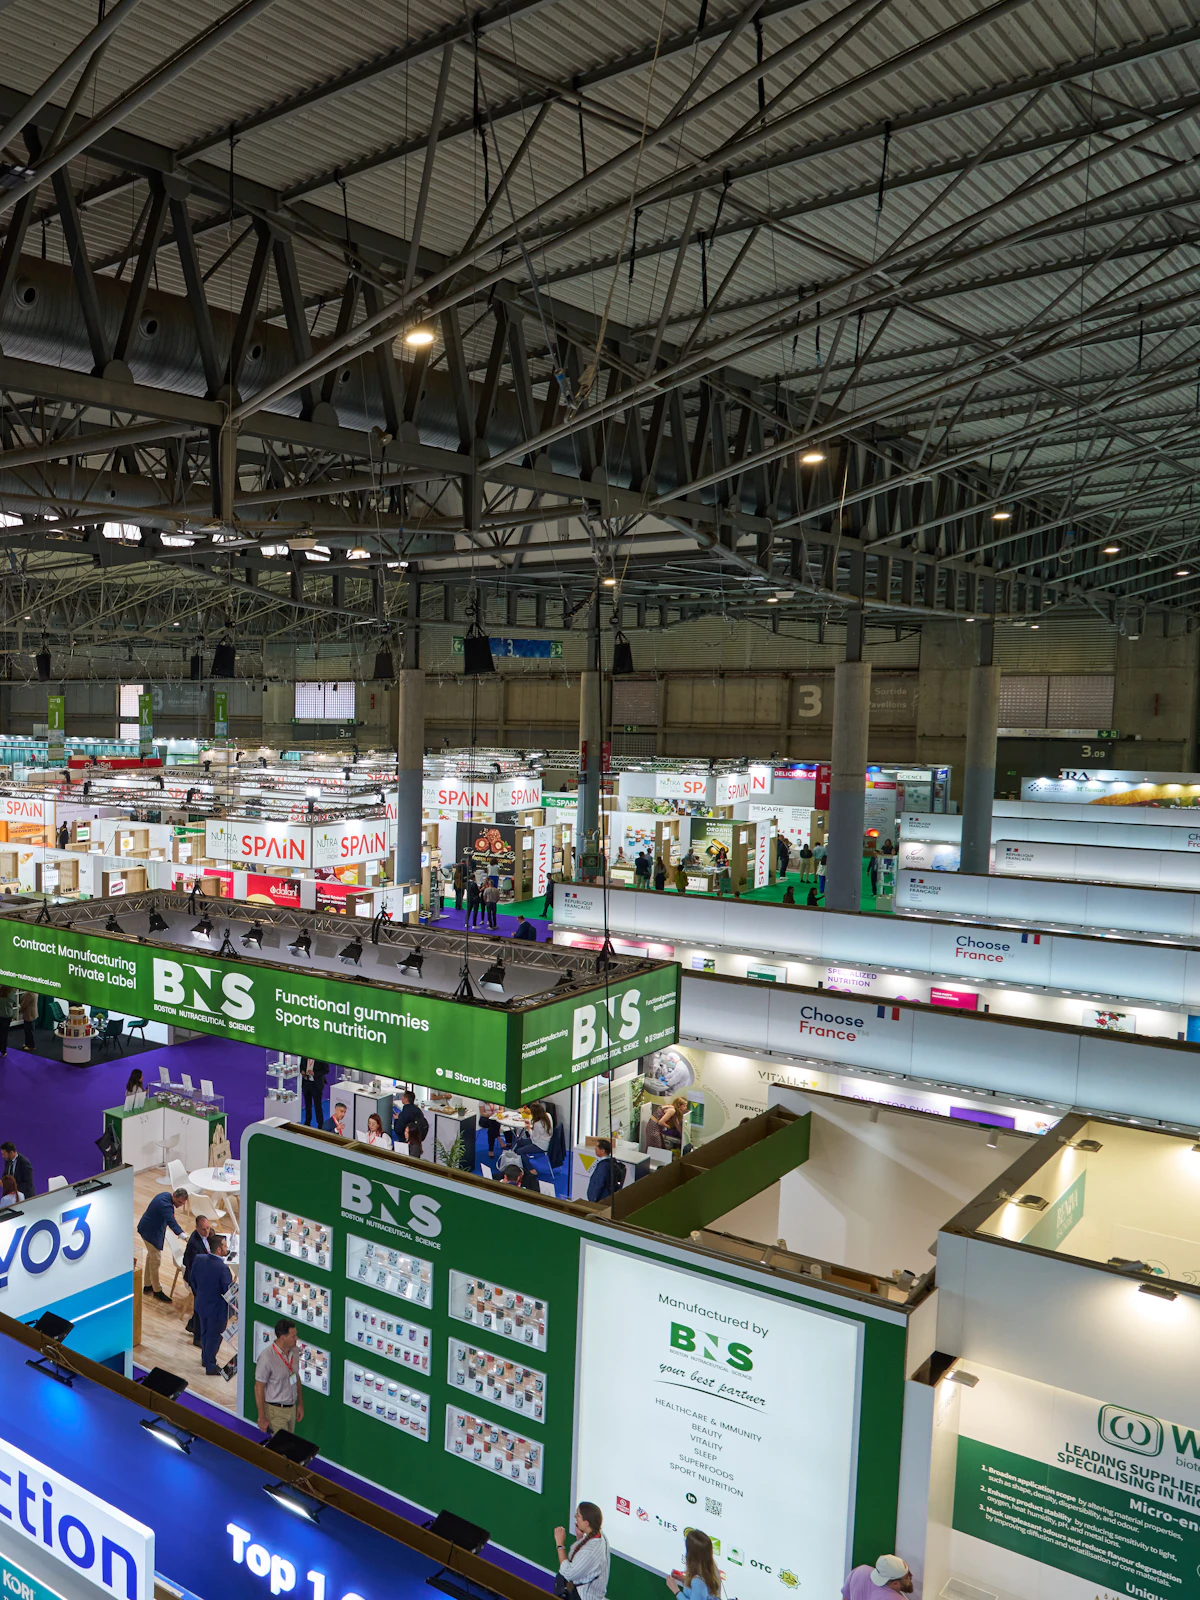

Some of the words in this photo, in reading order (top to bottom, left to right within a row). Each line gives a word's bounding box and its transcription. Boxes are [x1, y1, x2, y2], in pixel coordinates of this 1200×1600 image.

[142, 708, 149, 725] K
[219, 707, 224, 720] L
[798, 684, 822, 717] 3
[53, 712, 59, 729] J
[1081, 745, 1106, 758] 3.09
[13, 935, 56, 955] Contract
[57, 945, 137, 974] Manufacturing
[956, 935, 1010, 952] Choose
[68, 964, 105, 982] Private
[107, 973, 137, 990] Label
[153, 957, 256, 1020] BNS
[828, 975, 870, 987] NUTRITION
[154, 1003, 177, 1015] BOSTON
[179, 1009, 226, 1027] NUTRACEUTICAL
[228, 1021, 255, 1033] SCIENCE
[275, 988, 350, 1016] Functional
[354, 1006, 429, 1032] gummies
[275, 1008, 320, 1030] Sports
[323, 1021, 387, 1045] nutrition
[572, 989, 641, 1060] BNS
[800, 1006, 864, 1028] Choose
[455, 1072, 480, 1086] Stand
[481, 1077, 507, 1092] 3B136
[341, 1170, 442, 1238] BNS
[341, 1210, 364, 1224] BOSTON
[366, 1219, 413, 1241] NUTRACEUTICAL
[415, 1235, 441, 1250] SCIENCE
[658, 1293, 749, 1331] Manufactured
[752, 1322, 769, 1339] by
[670, 1321, 754, 1372] BNS
[659, 1363, 686, 1378] your
[690, 1370, 715, 1388] best
[717, 1383, 766, 1406] partner
[655, 1397, 708, 1422] HEALTHCARE
[711, 1417, 717, 1426] &
[720, 1421, 762, 1443] IMMUNITY
[691, 1423, 723, 1440] BEAUTY
[690, 1434, 723, 1452] VITALITY
[694, 1447, 718, 1462] SLEEP
[1065, 1442, 1127, 1471] LEADING
[669, 1462, 696, 1478] SPORT
[698, 1474, 744, 1498] NUTRITION
[678, 1453, 734, 1481] SUPERFOODS
[1057, 1451, 1155, 1493] SPECIALISING
[1158, 1485, 1174, 1500] IN
[988, 1466, 1017, 1481] Broaden
[1017, 1477, 1055, 1495] application
[1055, 1490, 1076, 1502] scope
[1078, 1497, 1087, 1507] by
[1087, 1501, 1114, 1517] altering
[1114, 1511, 1144, 1526] material
[1144, 1521, 1183, 1541] properties,
[988, 1475, 1004, 1485] such
[1011, 1483, 1033, 1496] shape,
[1102, 1515, 1117, 1525] and
[1117, 1520, 1140, 1533] odour.
[663, 1520, 678, 1532] IFS
[980, 1484, 987, 1492] 2.
[987, 1487, 1016, 1502] Enhance
[1016, 1498, 1043, 1512] product
[1043, 1506, 1072, 1523] stability
[1074, 1518, 1084, 1528] by
[1084, 1523, 1114, 1539] reducing
[1114, 1533, 1150, 1552] sensitivity
[1150, 1546, 1158, 1554] to
[1158, 1549, 1178, 1562] light,
[226, 1522, 296, 1596] Top
[750, 1558, 772, 1574] OTC
